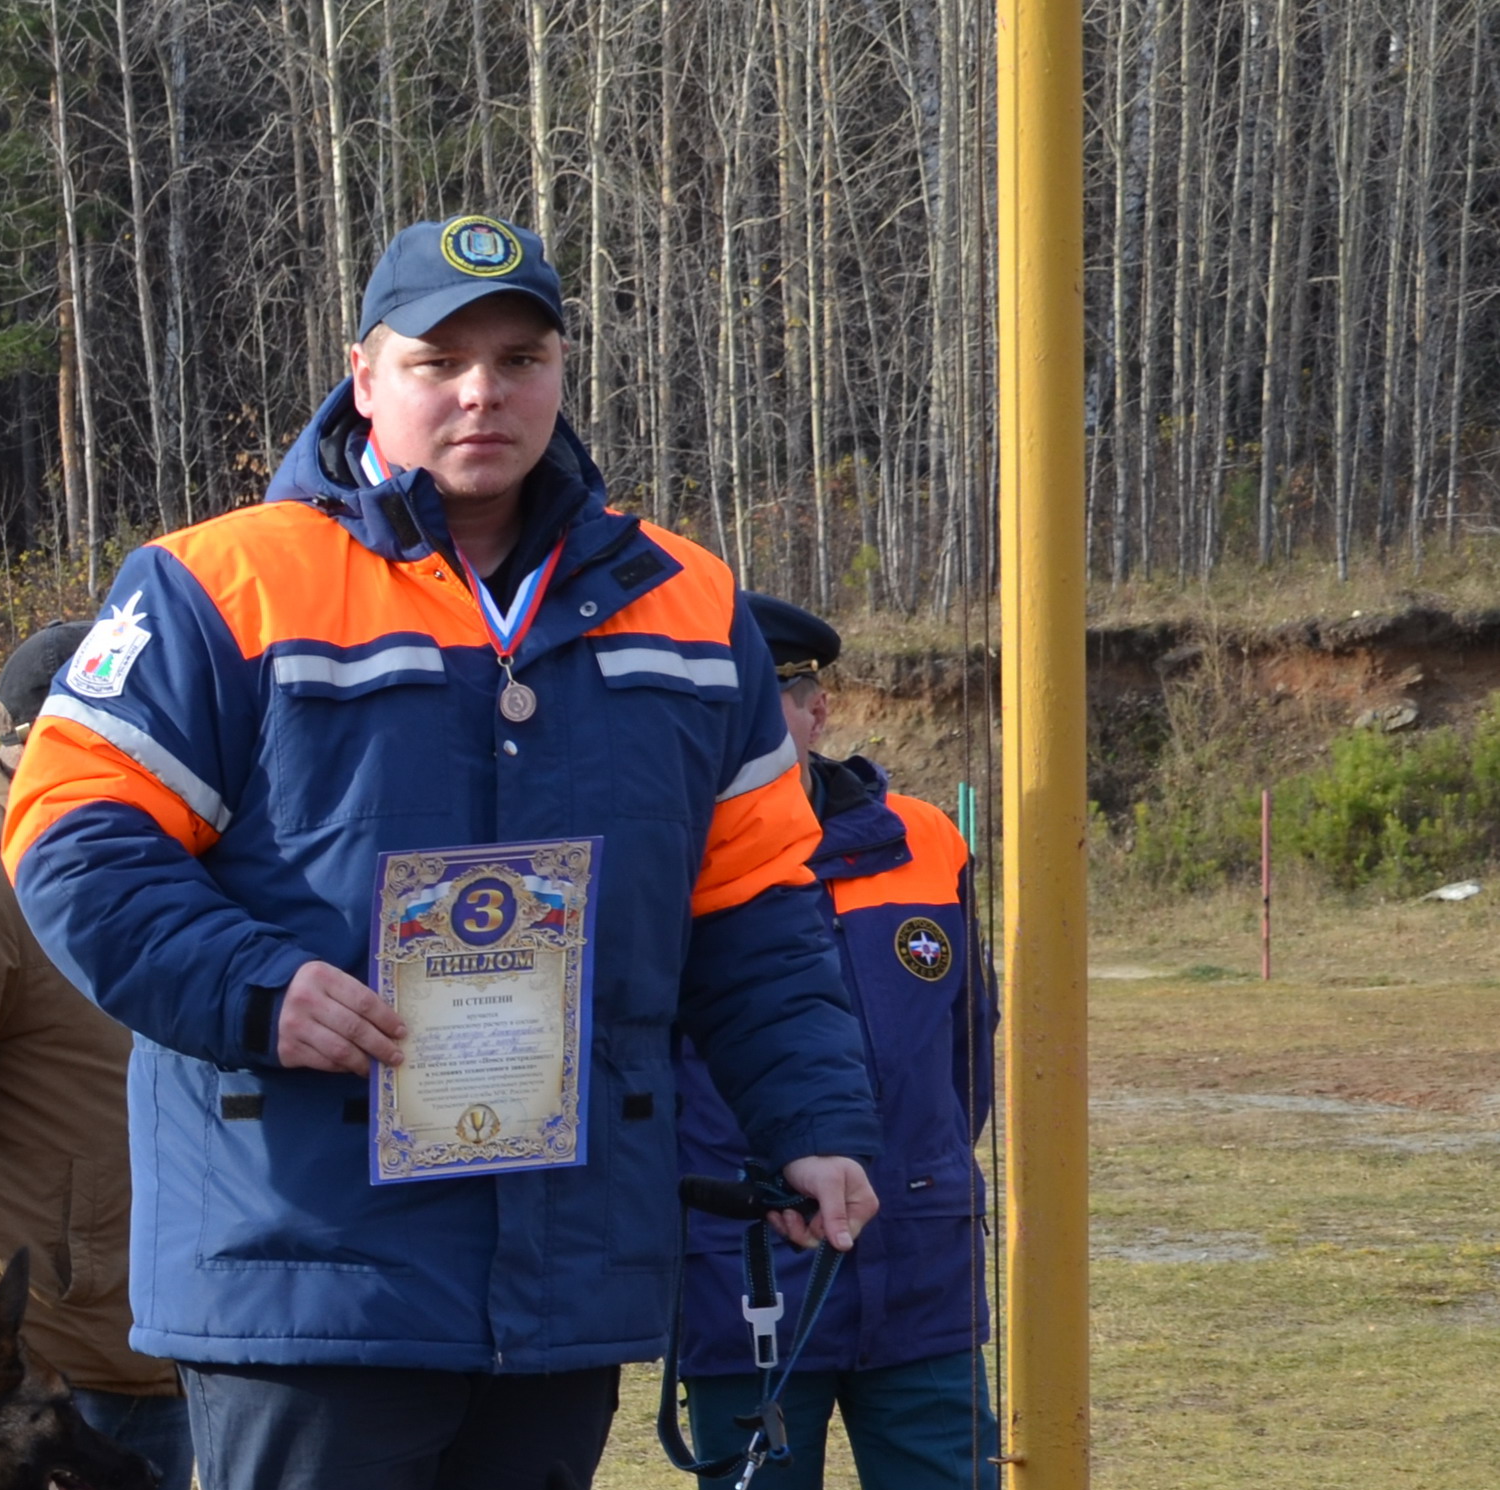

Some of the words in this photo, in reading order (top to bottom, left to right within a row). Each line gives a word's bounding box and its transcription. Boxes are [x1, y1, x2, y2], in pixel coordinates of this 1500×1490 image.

[463, 889, 504, 933] 3
[430, 954, 535, 977] ДИПЛОМ
[466, 995, 513, 1006] СТЕПЕНИ
